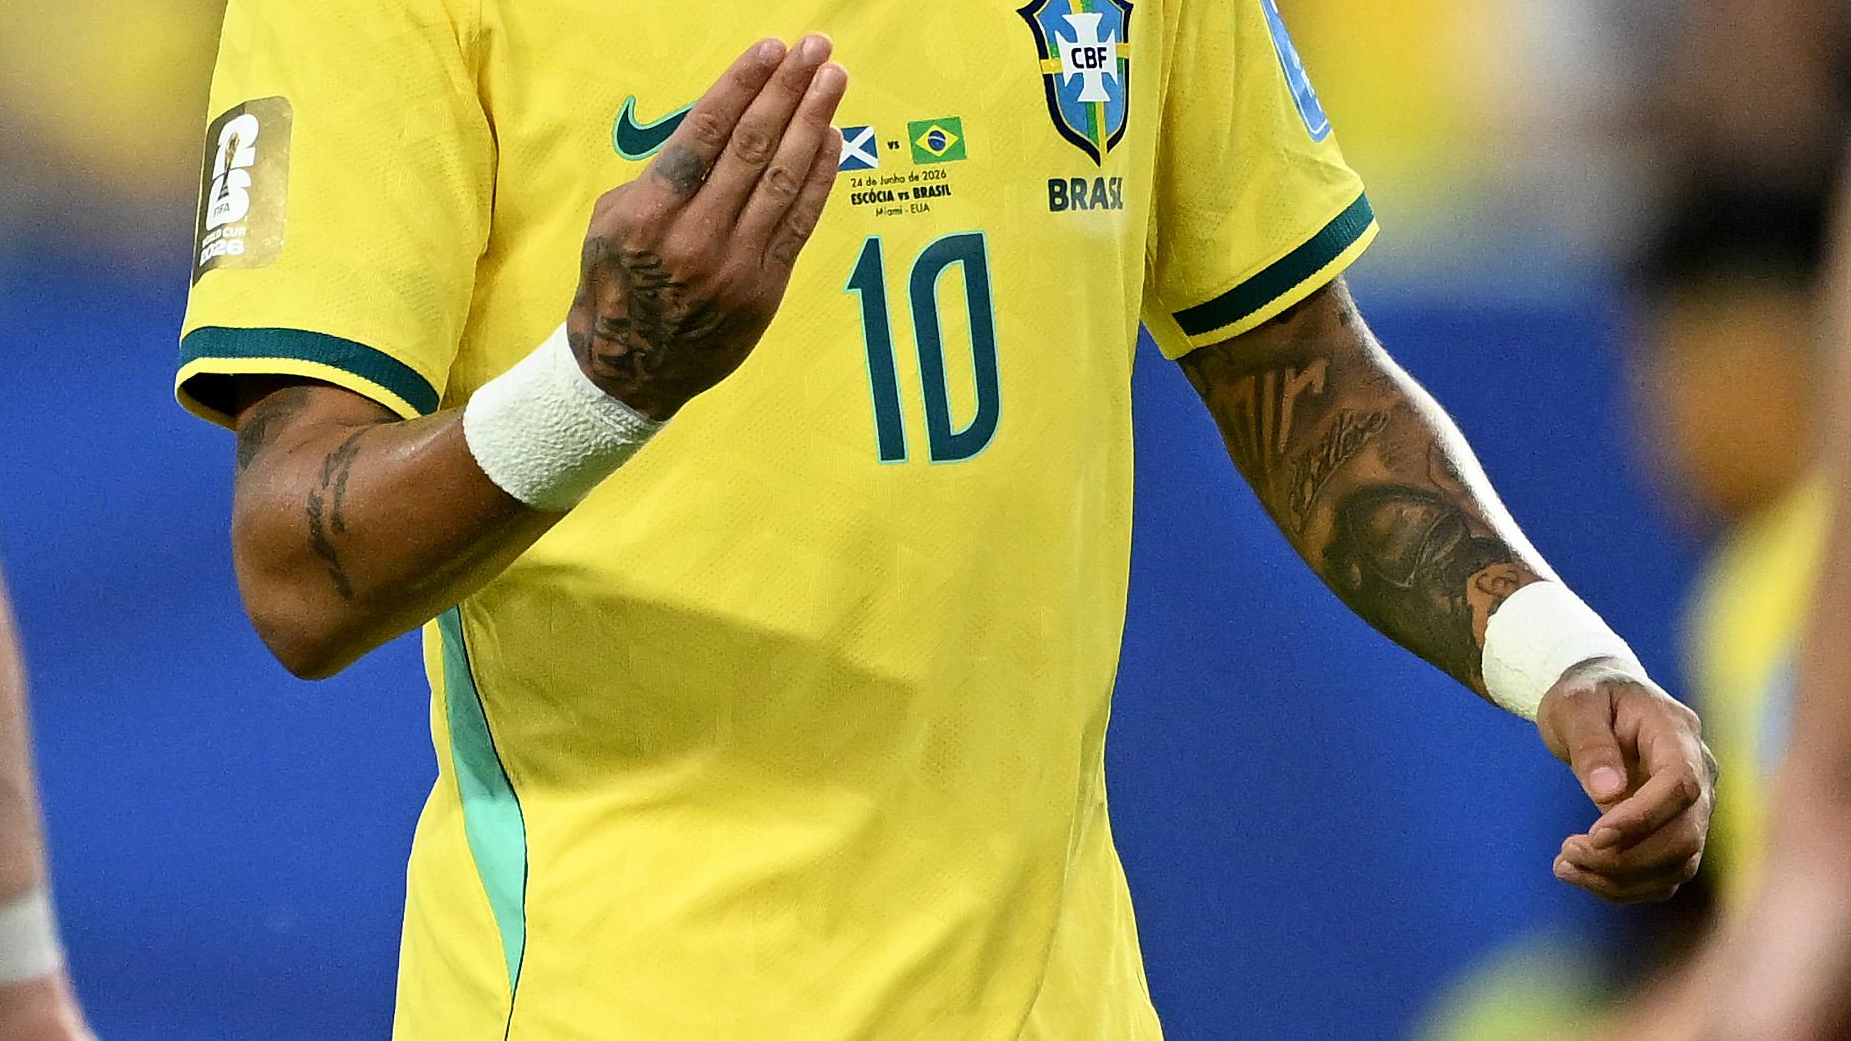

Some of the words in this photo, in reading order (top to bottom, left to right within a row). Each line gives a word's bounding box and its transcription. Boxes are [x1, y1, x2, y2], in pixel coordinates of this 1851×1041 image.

[1071, 47, 1107, 69] CBF
[851, 178, 863, 188] 24
[866, 176, 877, 186] de
[909, 171, 919, 182] de
[922, 169, 947, 181] 2026
[851, 188, 894, 205] ESCÓCIA
[897, 191, 910, 200] vs
[912, 184, 951, 199] BRASIL
[1048, 177, 1123, 212] BRASL
[213, 202, 230, 217] FIFA
[876, 205, 902, 216] Miami
[910, 203, 930, 214] EUA
[222, 226, 246, 238] CUP
[844, 230, 1002, 466] 10
